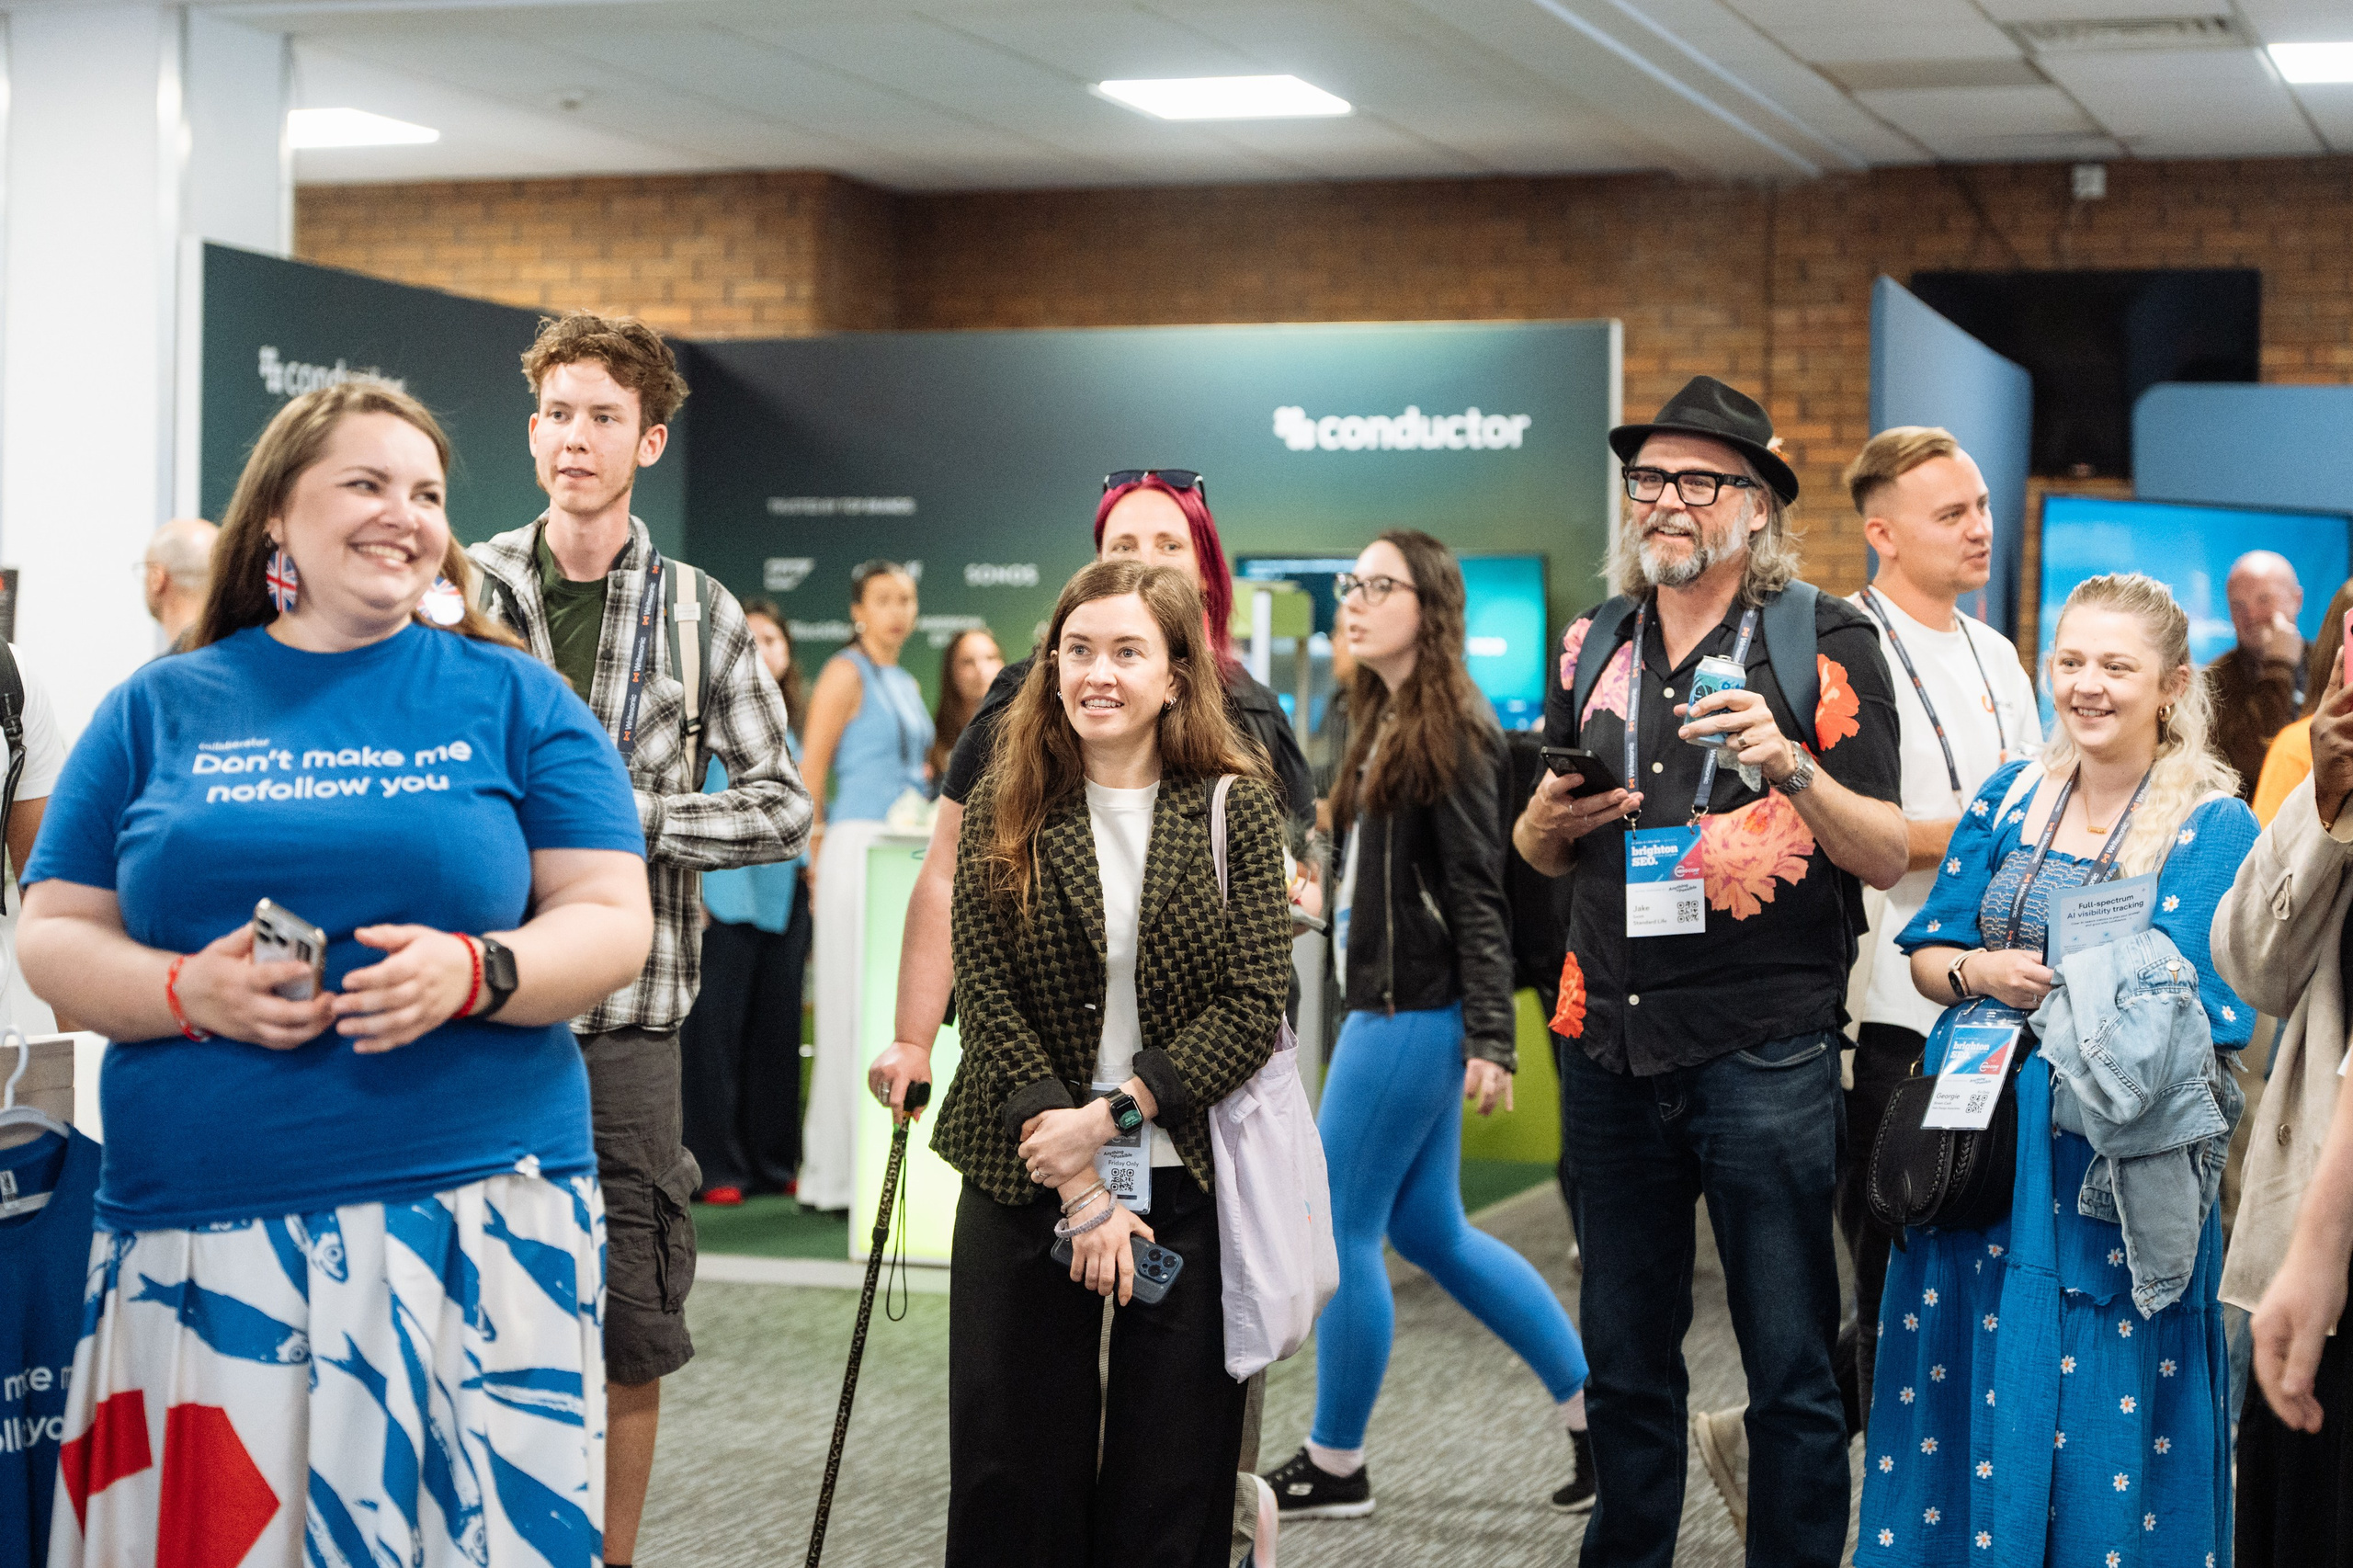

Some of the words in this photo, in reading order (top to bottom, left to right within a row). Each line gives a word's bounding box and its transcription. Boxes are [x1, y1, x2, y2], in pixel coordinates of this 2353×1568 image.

[1317, 405, 1531, 451] conductor
[643, 582, 656, 616] Writesonic
[632, 636, 646, 672] Writesonic
[624, 693, 638, 731] Writesonic
[1629, 687, 1638, 722] Writesonic
[192, 749, 293, 774] Don't
[302, 746, 405, 768] make
[415, 740, 472, 767] me
[1702, 748, 1717, 785] Writesonic
[206, 776, 371, 803] nofollow
[380, 773, 450, 798] you
[1631, 845, 1678, 858] brighton
[2032, 832, 2052, 864] Writesonic
[2107, 822, 2130, 854] Writesonic
[1631, 857, 1658, 867] SEO.
[2012, 883, 2029, 918] Writesonic
[2077, 907, 2111, 918] visibility
[2113, 901, 2144, 913] tracking
[2079, 895, 2133, 909] Full-spectrum
[1953, 1041, 1990, 1051] brighton
